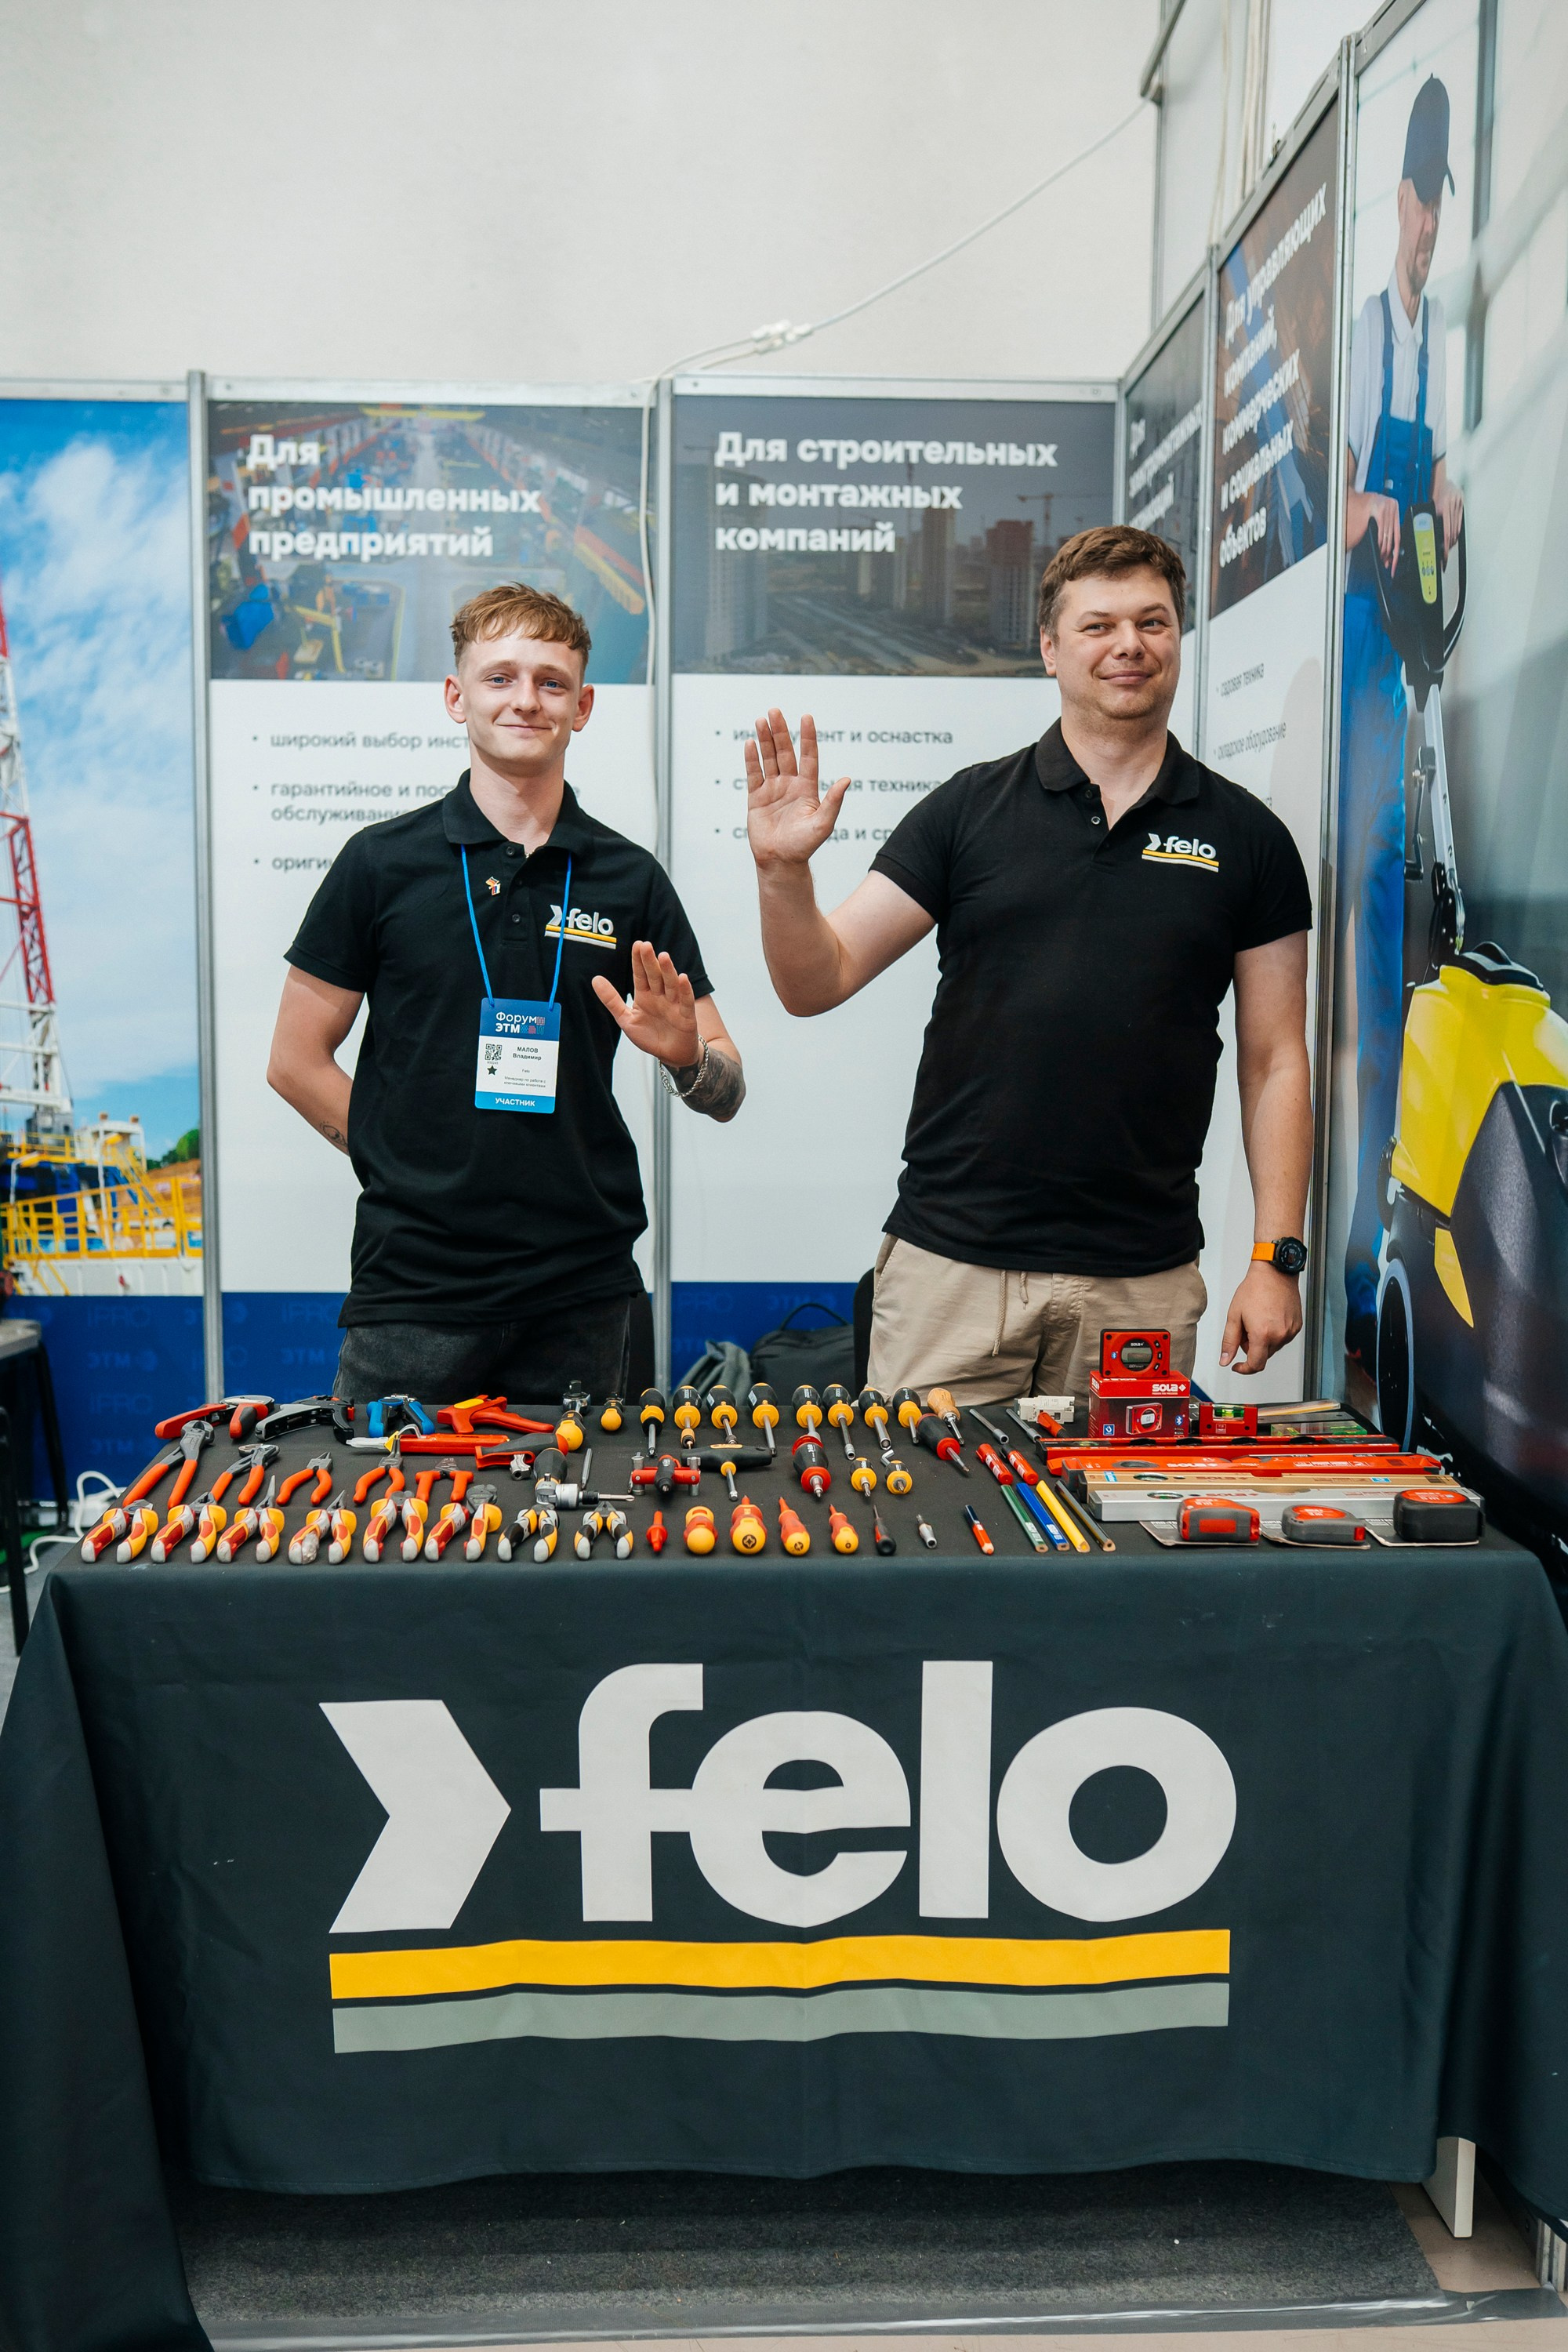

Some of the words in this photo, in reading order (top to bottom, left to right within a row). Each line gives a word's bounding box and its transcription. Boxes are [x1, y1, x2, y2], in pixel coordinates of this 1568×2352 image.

[247, 434, 320, 471] Для
[715, 432, 787, 467] Для
[797, 437, 1058, 470] строительных
[249, 485, 542, 517] промышленных
[716, 483, 739, 506] и
[749, 484, 963, 510] монтажных
[249, 526, 494, 563] предприятий
[716, 522, 895, 552] компаний
[1219, 507, 1267, 568] объектов
[270, 732, 356, 750] широкий
[362, 733, 423, 752] выбор
[851, 732, 862, 743] и
[868, 731, 954, 745] оснастка
[270, 780, 392, 800] гарантийное
[398, 785, 410, 797] и
[270, 804, 405, 826] обслуживани
[855, 828, 866, 840] и
[1163, 835, 1217, 860] felo
[566, 908, 615, 936] felo
[495, 1011, 537, 1025] Форум
[495, 1022, 521, 1034] ЭТМ
[495, 1097, 535, 1107] УЧАСТНИК
[539, 1661, 1237, 1928] felo
